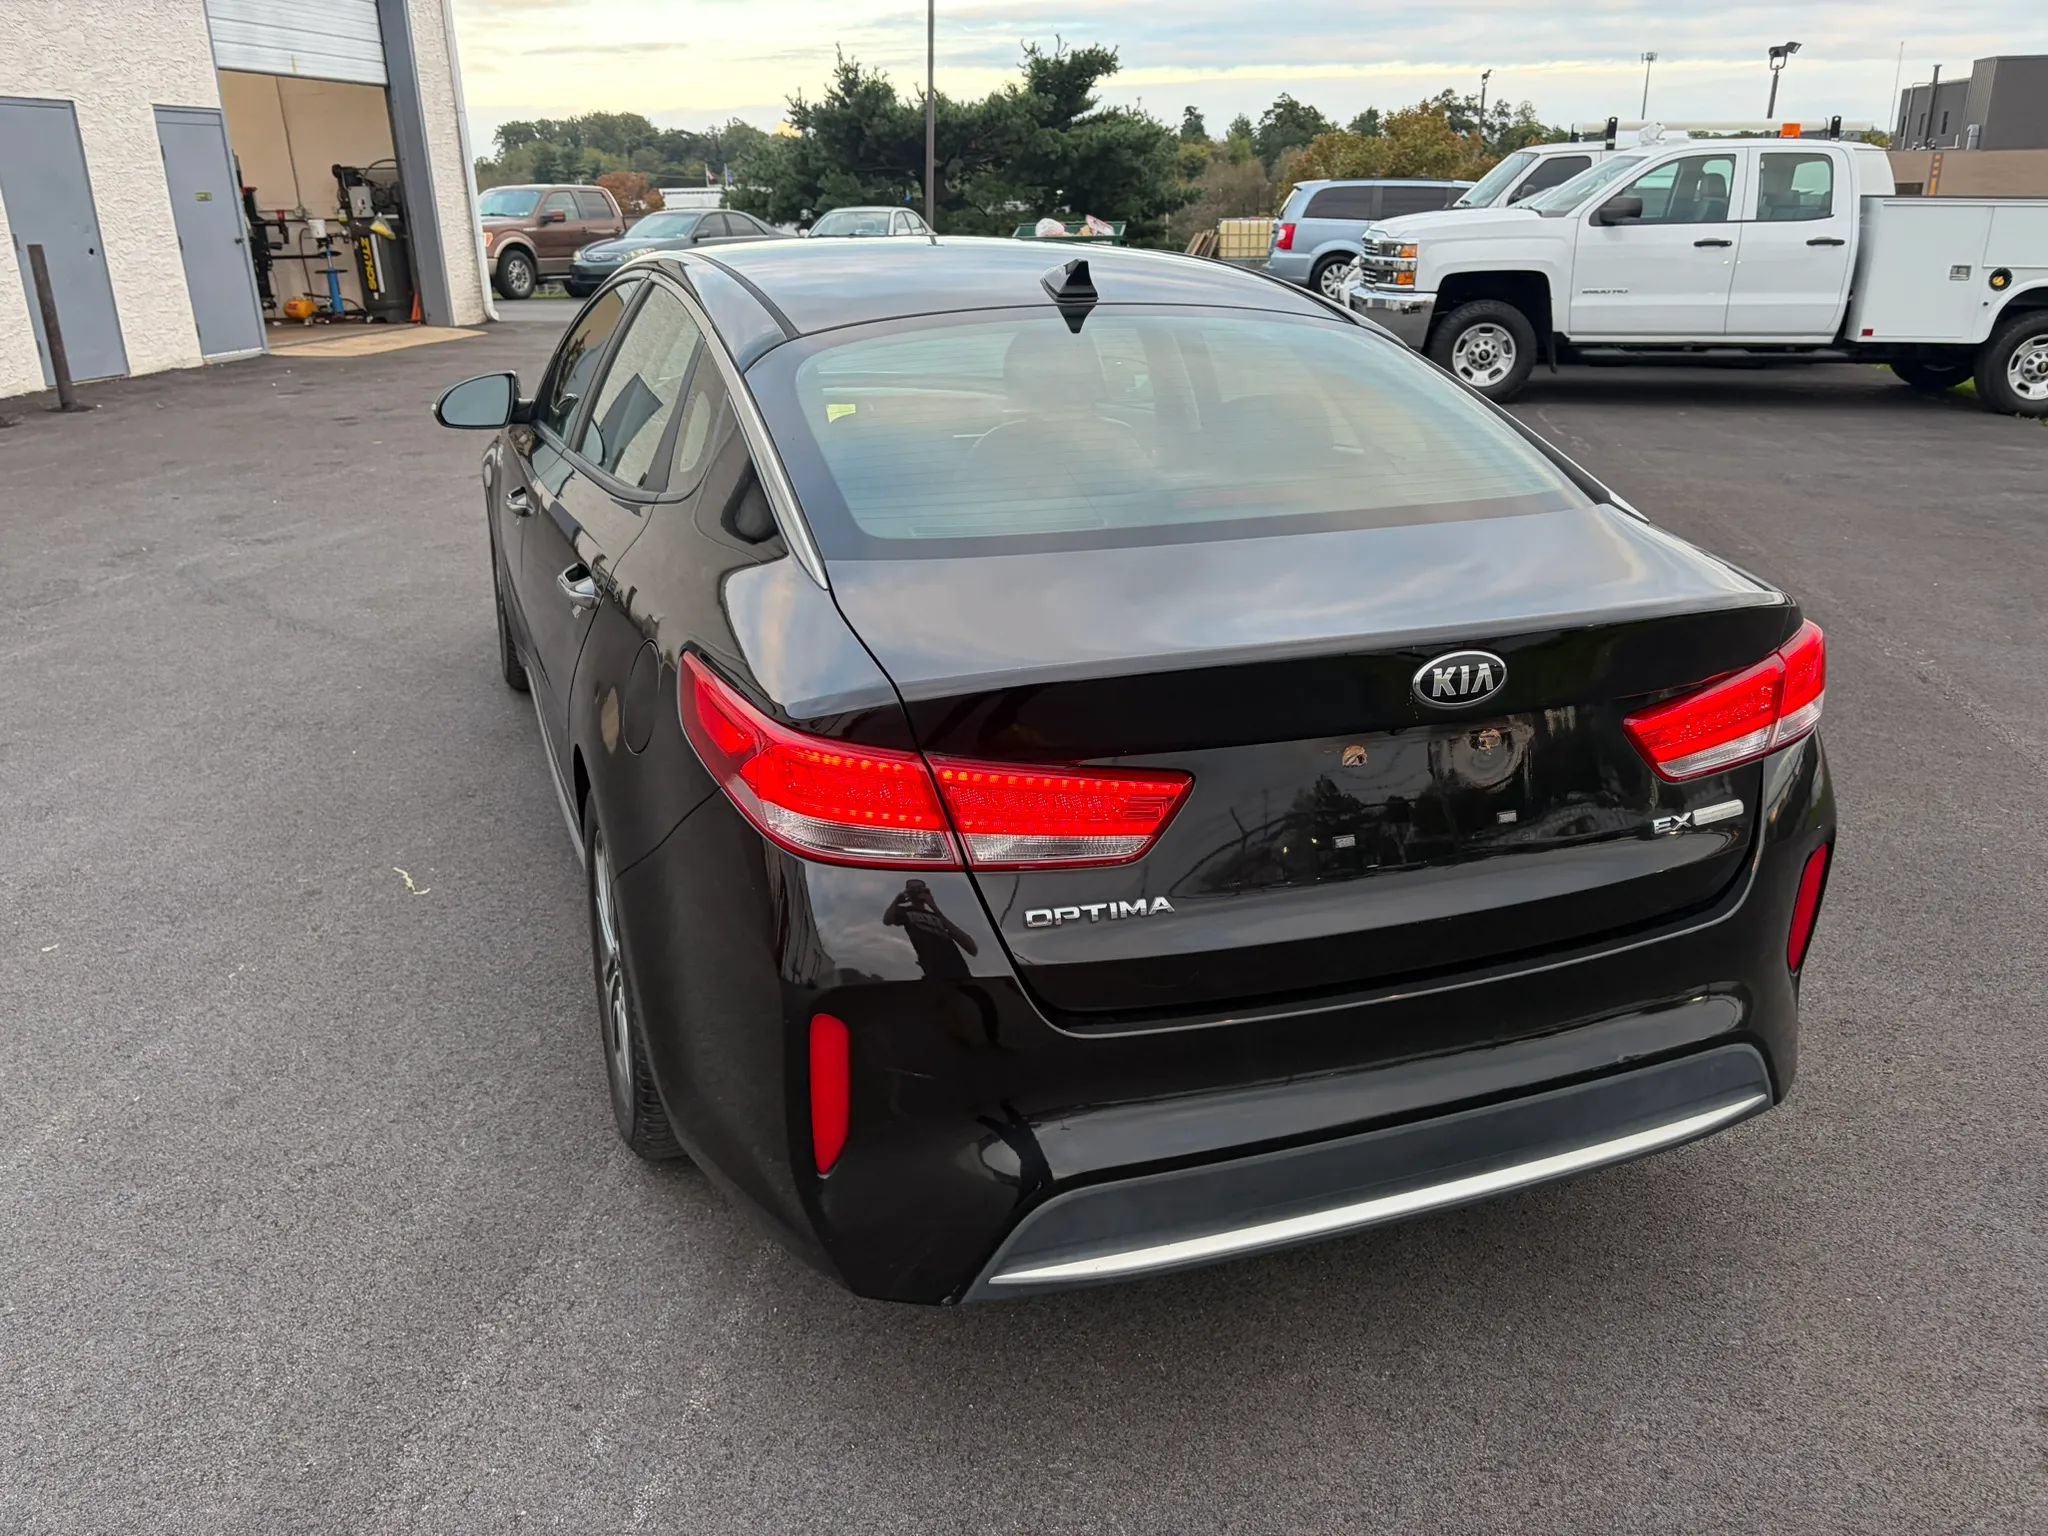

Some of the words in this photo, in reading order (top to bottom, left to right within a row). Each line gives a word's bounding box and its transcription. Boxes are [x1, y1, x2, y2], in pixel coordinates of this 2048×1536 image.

[1432, 662, 1494, 697] KIA
[1652, 811, 1692, 835] EX
[1024, 895, 1176, 928] OPTIMA
